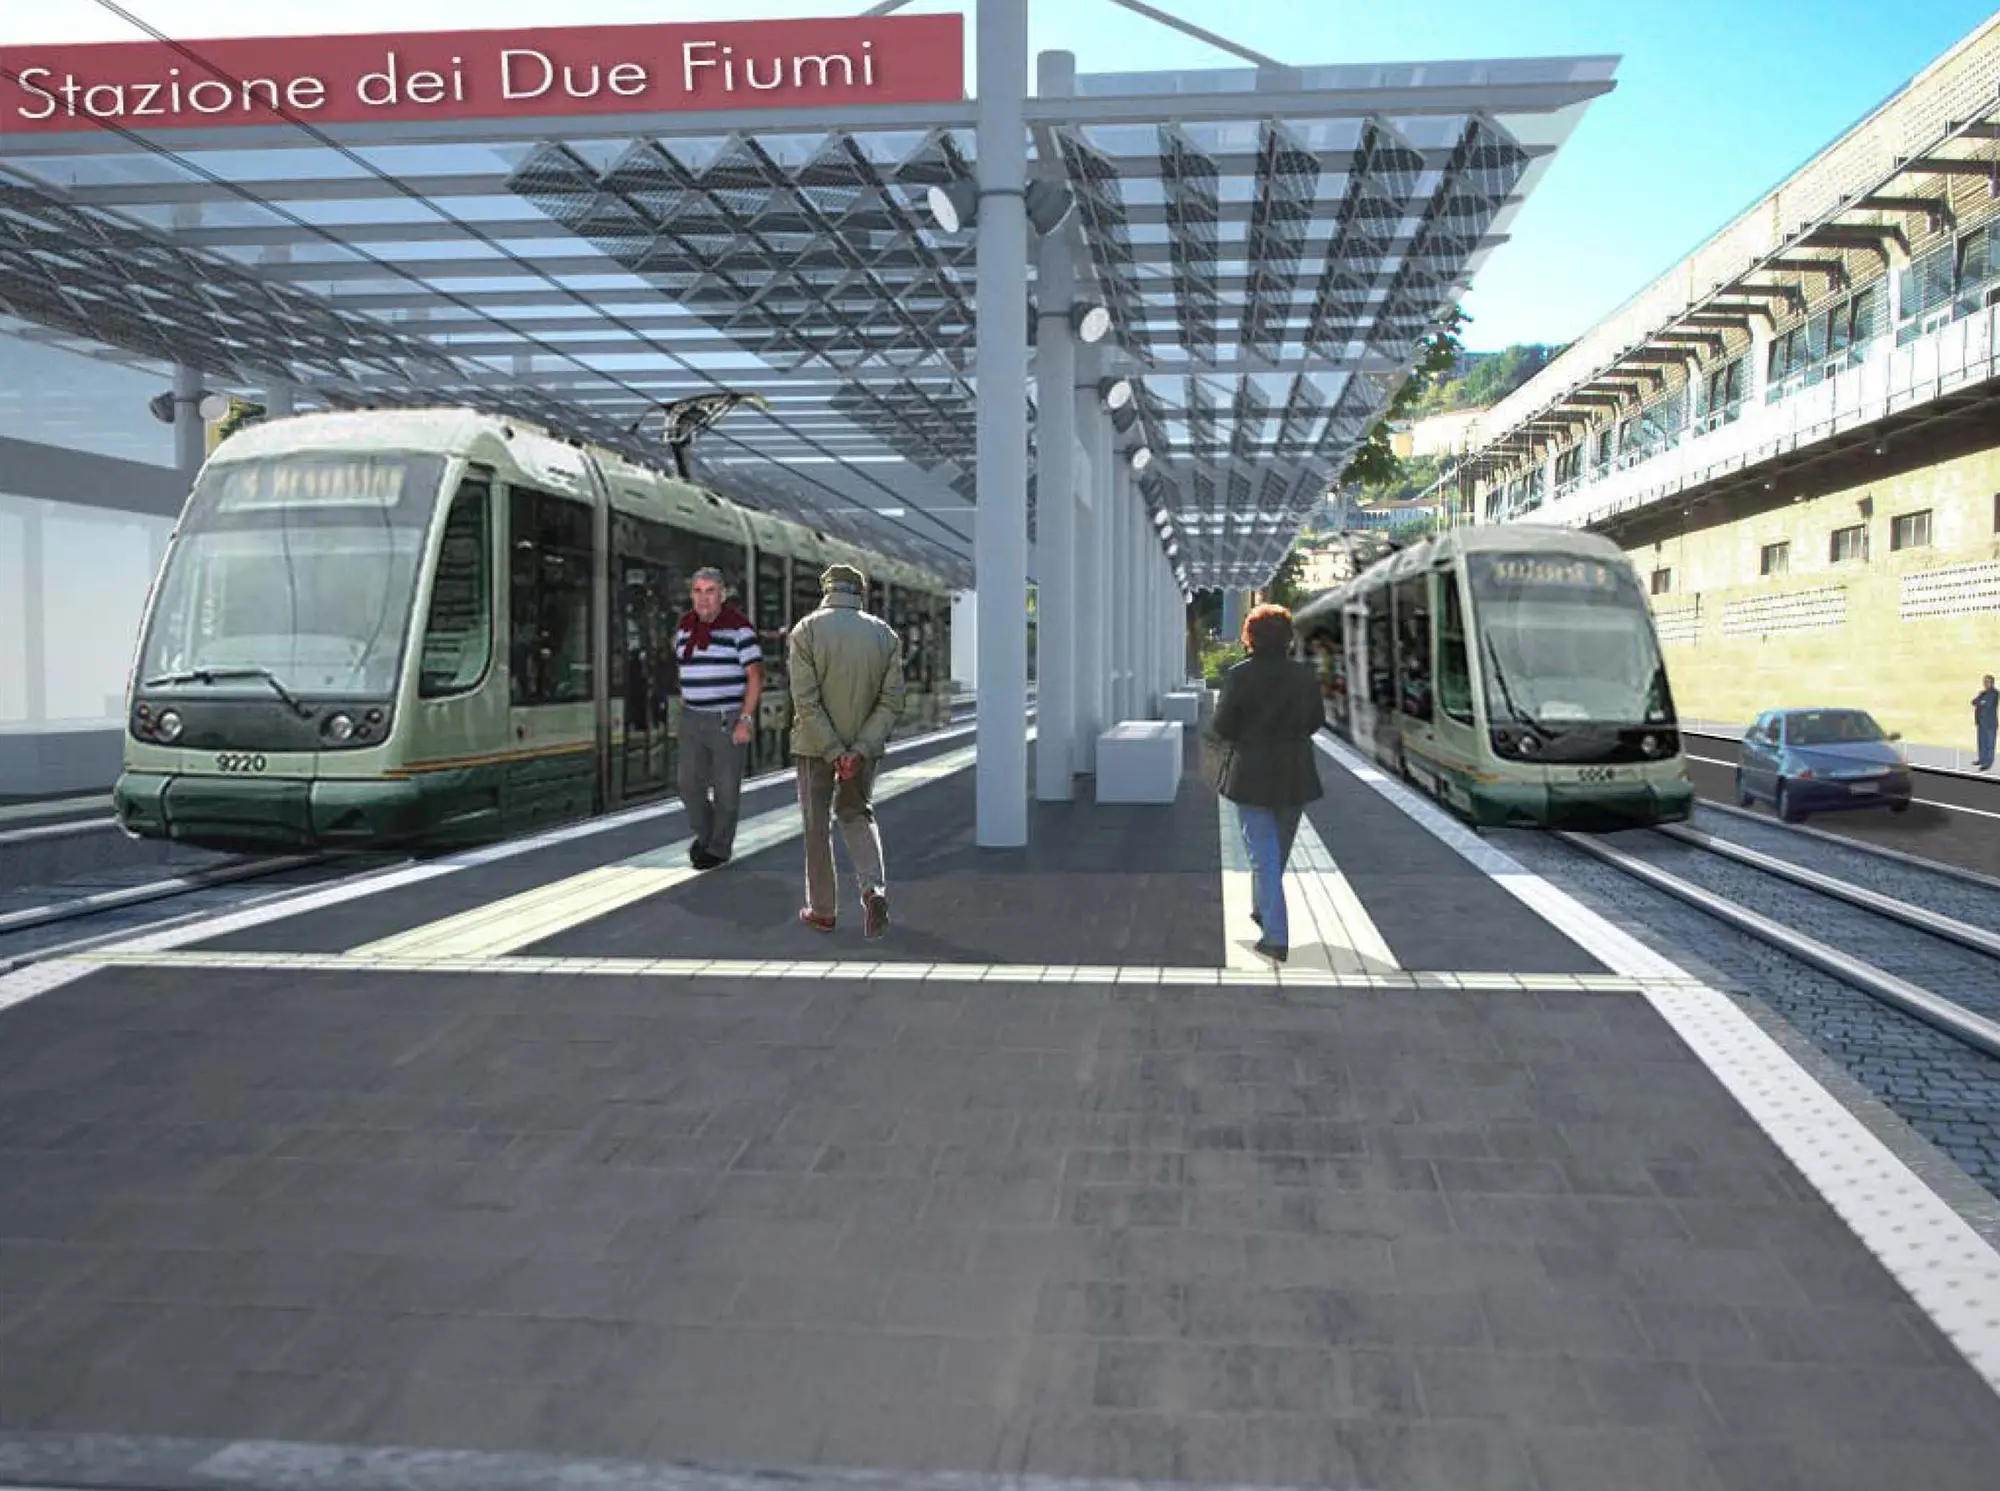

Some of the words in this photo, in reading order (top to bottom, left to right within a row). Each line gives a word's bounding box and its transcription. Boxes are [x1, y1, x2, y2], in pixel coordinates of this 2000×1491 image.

[18, 68, 326, 119] Stazione
[356, 51, 464, 105] dei
[500, 49, 647, 98] Due
[682, 40, 874, 91] Fiumi
[216, 754, 267, 772] 9220
